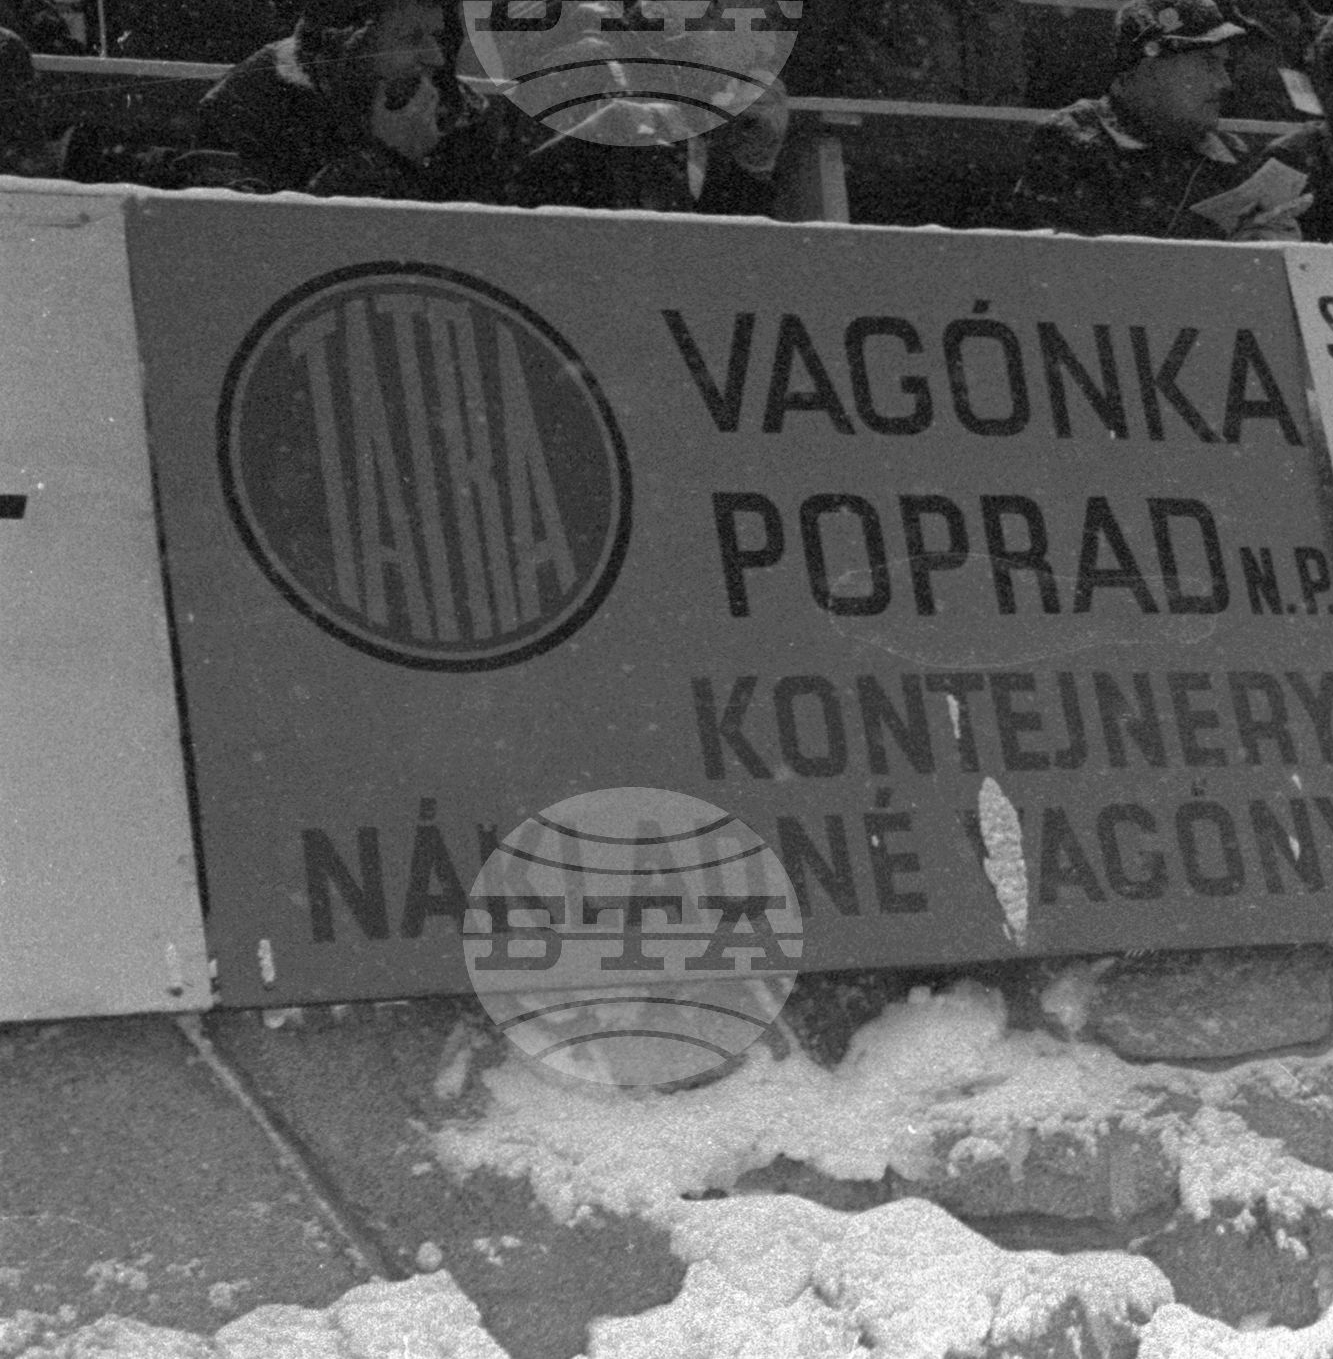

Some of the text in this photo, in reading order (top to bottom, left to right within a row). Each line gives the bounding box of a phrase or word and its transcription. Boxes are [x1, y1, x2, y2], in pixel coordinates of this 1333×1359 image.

[661, 299, 1304, 447] VAGÓNKA
[286, 293, 578, 641] TATRA
[711, 492, 1230, 617] POPRAD
